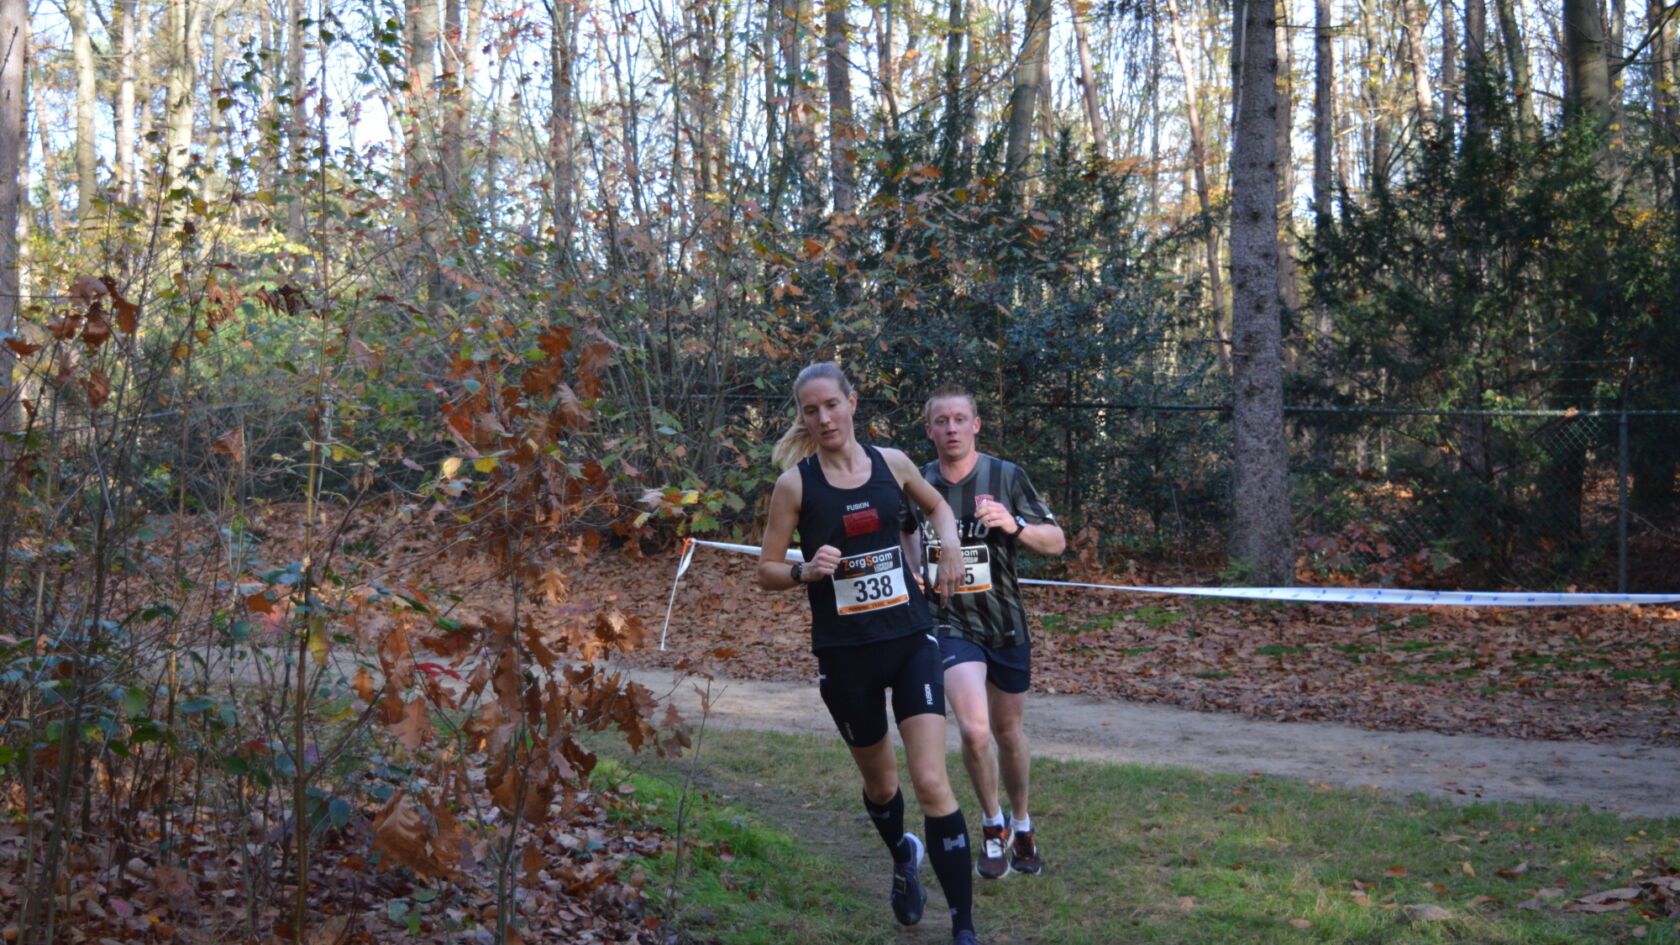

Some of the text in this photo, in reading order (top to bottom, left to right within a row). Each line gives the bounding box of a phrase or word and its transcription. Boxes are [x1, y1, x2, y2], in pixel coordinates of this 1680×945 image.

[846, 501, 870, 511] FUSION
[842, 552, 893, 571] ZorgSaam
[853, 574, 894, 603] 338
